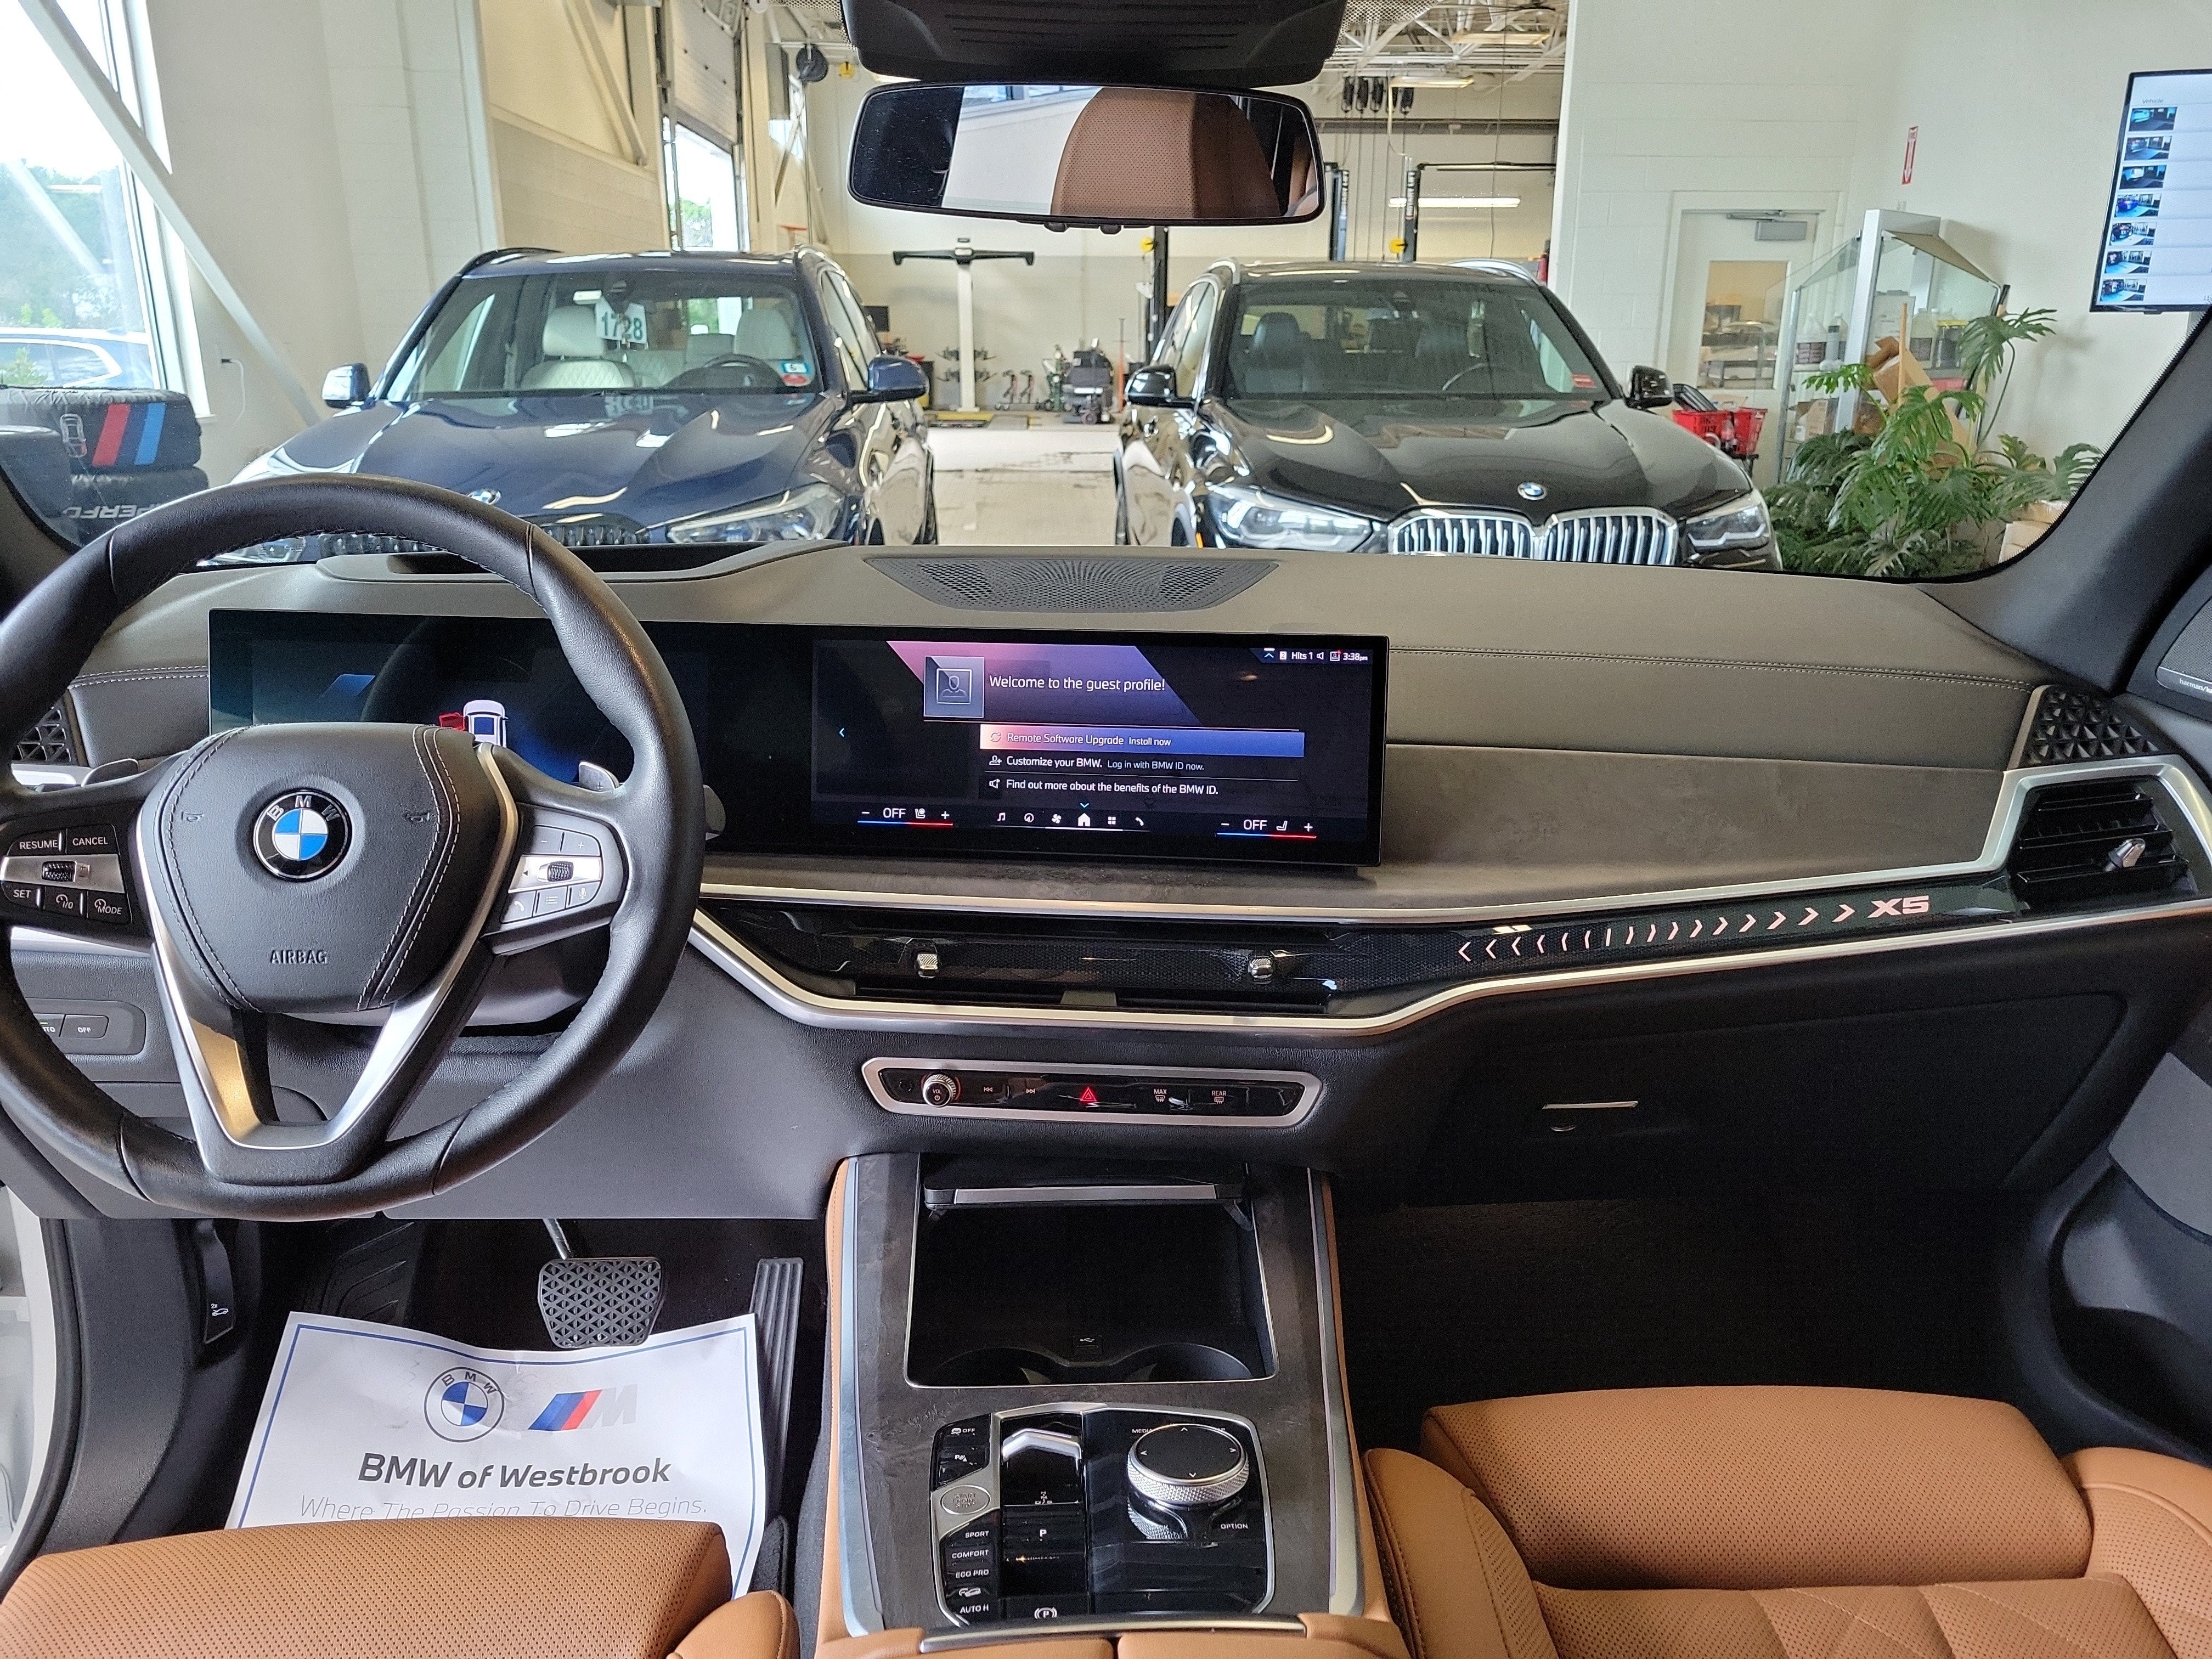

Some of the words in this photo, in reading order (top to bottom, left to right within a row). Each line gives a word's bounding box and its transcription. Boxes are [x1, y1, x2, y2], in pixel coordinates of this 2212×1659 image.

[1291, 651, 1307, 660] Hits
[1308, 652, 1313, 660] 1
[1342, 652, 1368, 662] 3:38pm
[989, 675, 1045, 688] Welcome
[1048, 678, 1059, 689] to
[1064, 677, 1083, 689] the
[1086, 680, 1121, 691] guest
[1124, 679, 1165, 692] profile!
[1007, 732, 1041, 743] Remote
[1043, 733, 1084, 744] Software
[1086, 735, 1124, 747] Upgrade
[1128, 737, 1152, 746] Install
[1007, 755, 1053, 766] Customize
[1054, 759, 1074, 768] your
[1076, 758, 1103, 768] BMW.
[1107, 760, 1122, 769] Log
[1124, 760, 1131, 769] in
[1133, 760, 1150, 769] with
[1152, 761, 1173, 770] BMW
[1175, 761, 1184, 770] ID
[1006, 780, 1026, 789] Find
[1028, 781, 1042, 789] out
[1045, 782, 1068, 791] more
[1069, 781, 1096, 791] about
[1097, 783, 1112, 792] the
[1114, 783, 1149, 793] benefits
[1151, 784, 1161, 793] of
[1163, 785, 1177, 794] the
[1179, 785, 1205, 794] BMW
[1206, 786, 1218, 795] ID.
[267, 795, 341, 821] BMW
[883, 808, 906, 819] OFF
[1243, 819, 1268, 831] OFF
[19, 839, 58, 850] RESUME
[72, 837, 109, 846] CANCEL
[13, 889, 31, 898] SET
[97, 906, 123, 915] MODE
[1867, 895, 1929, 918] X5
[270, 949, 328, 965] AIRBAG
[442, 1371, 498, 1395] BMW
[358, 1453, 452, 1488] BMW
[458, 1465, 495, 1489] of
[500, 1457, 672, 1488] Westbrook
[301, 1495, 374, 1520] Where
[383, 1502, 424, 1520] The
[432, 1502, 520, 1517] Passion
[530, 1500, 557, 1517] To
[565, 1499, 620, 1516] Drive
[628, 1497, 707, 1518] Begins.
[1040, 1529, 1047, 1537] P
[951, 1549, 989, 1559] COMFORT
[960, 1605, 981, 1614] AUTO
[983, 1603, 989, 1611] H
